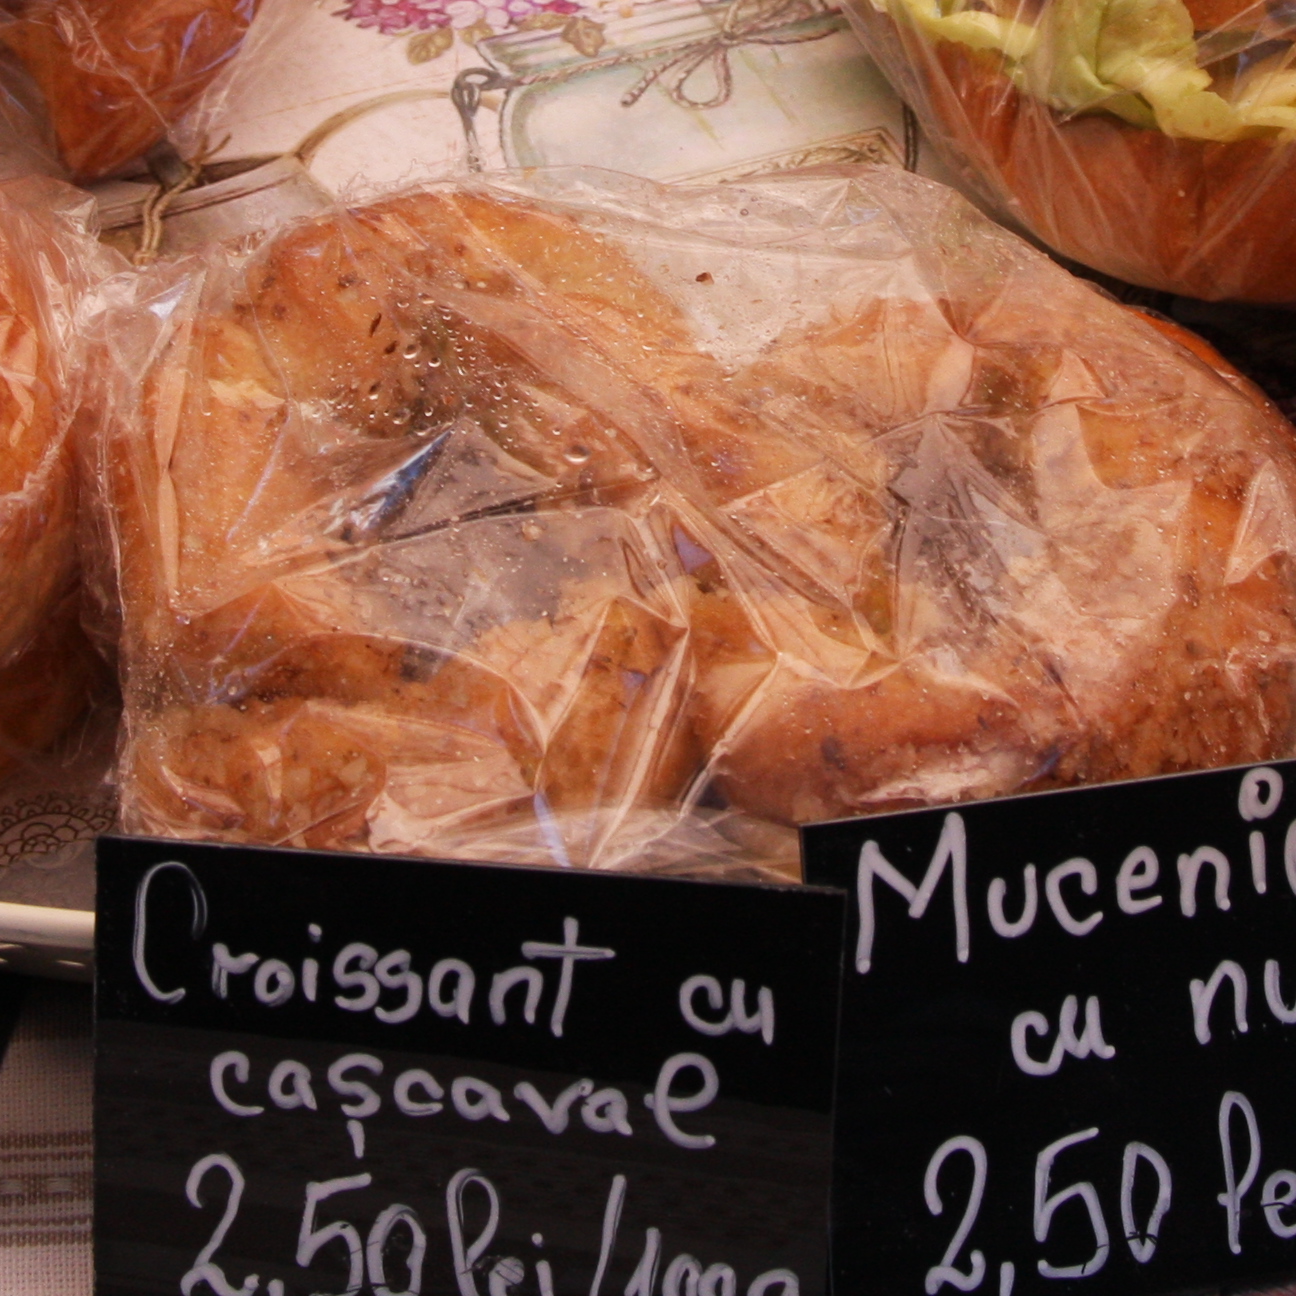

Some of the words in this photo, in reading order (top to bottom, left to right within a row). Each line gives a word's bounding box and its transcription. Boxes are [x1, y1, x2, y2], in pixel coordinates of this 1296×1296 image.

[133, 860, 615, 1037] Croissant
[680, 973, 774, 1045] cu
[210, 1051, 719, 1159] cașcaval
[1010, 995, 1116, 1076] cu
[924, 1126, 1172, 1296] 2,50
